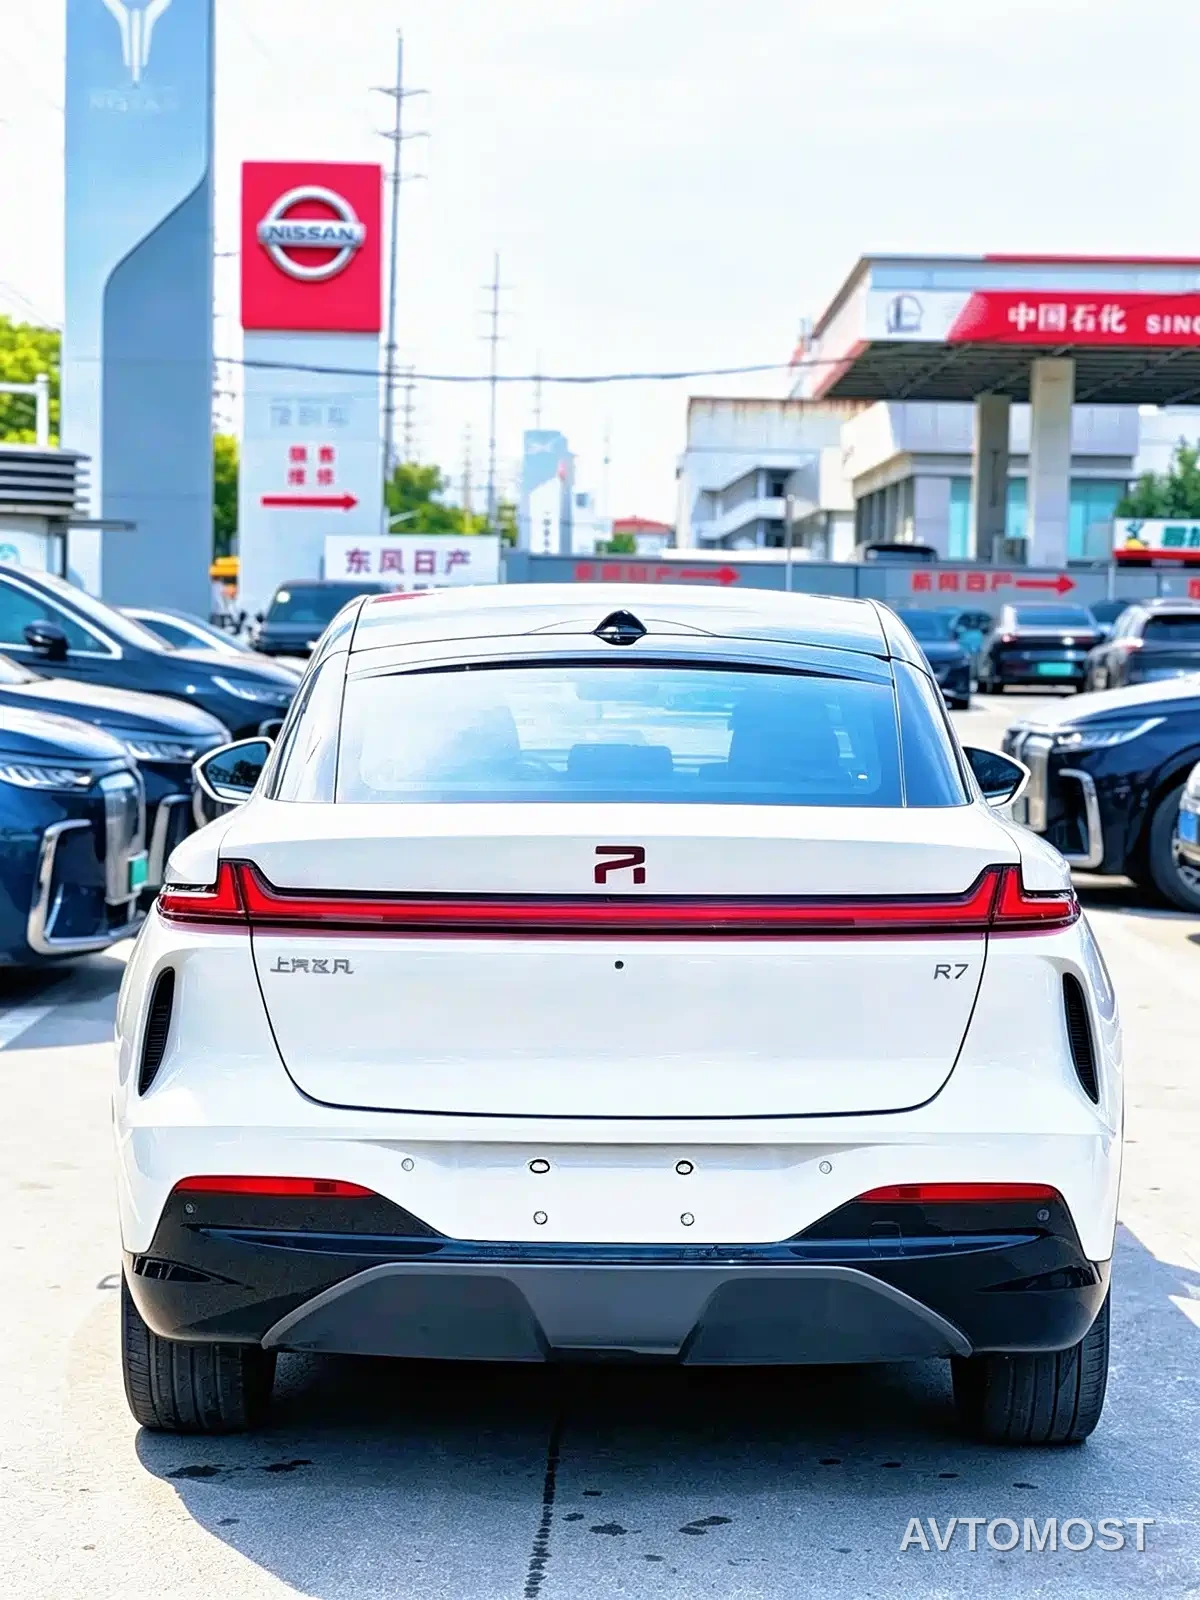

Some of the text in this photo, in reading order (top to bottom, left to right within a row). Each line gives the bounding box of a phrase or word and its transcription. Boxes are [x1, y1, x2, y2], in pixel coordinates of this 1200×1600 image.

[267, 225, 354, 240] NISSAN
[1007, 302, 1127, 333] 中国石化
[345, 549, 471, 574] 东风日产
[269, 956, 354, 974] 上汽飞凡
[933, 963, 969, 980] R7
